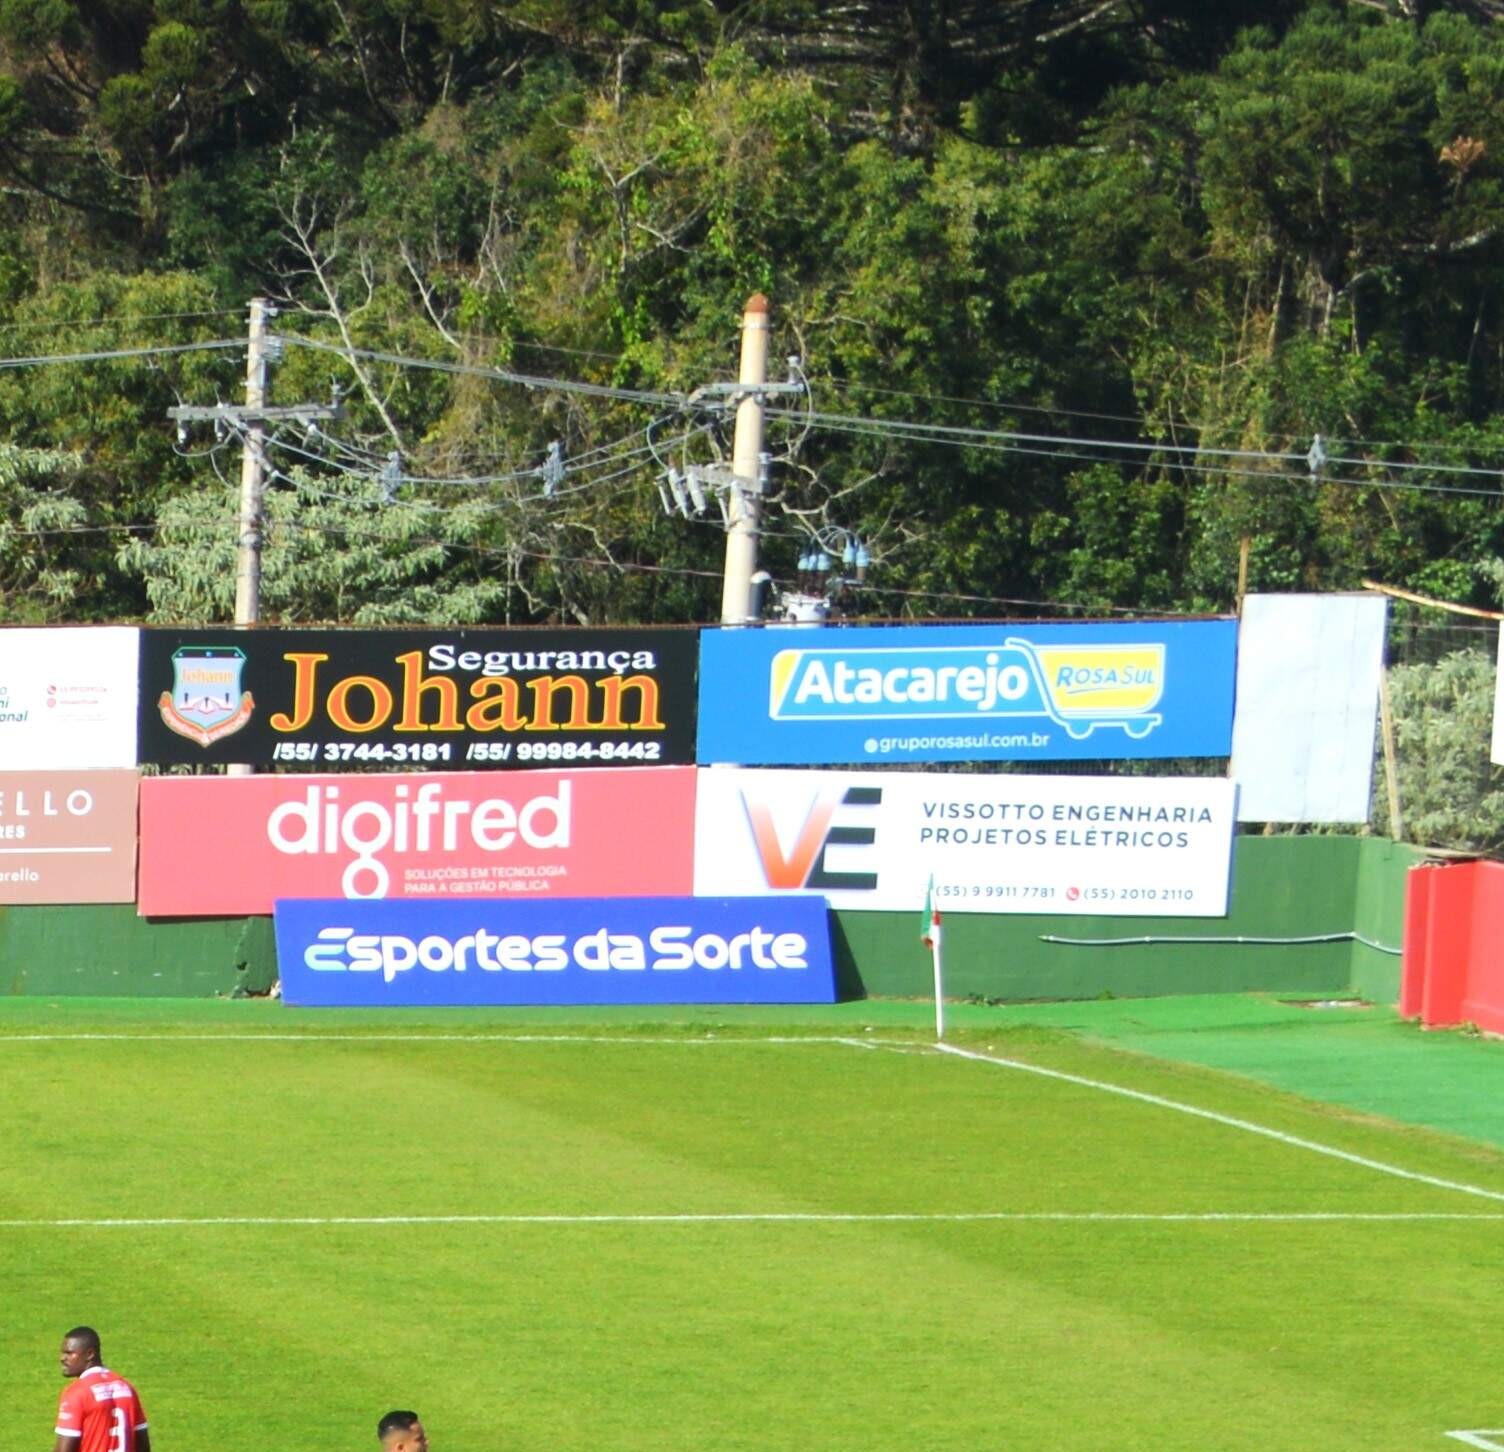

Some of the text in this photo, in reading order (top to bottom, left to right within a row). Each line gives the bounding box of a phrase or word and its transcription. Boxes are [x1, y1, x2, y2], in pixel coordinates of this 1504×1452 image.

[428, 644, 656, 677] Segurança
[268, 650, 666, 733] Johann
[793, 652, 1029, 711] Atacarejo
[272, 741, 661, 762] /55/ 3744-3181 /55/ 99984-8442
[879, 733, 1051, 756] gruporosasul.com.br
[922, 801, 1214, 825] VISSOTTO ENGENHARIA
[267, 779, 572, 899] digifred
[918, 824, 1190, 848] PROJETOS ELÉTRICOS
[404, 865, 568, 881] SOLUÇÕES EM TECNOLOGIA
[404, 882, 436, 894] PARA
[439, 883, 448, 893] A
[449, 880, 497, 893] GESTÃO
[935, 885, 968, 897] (55)
[972, 886, 981, 897] 9
[1083, 887, 1194, 901] (55) 2010 2110
[304, 925, 809, 984] Esportes da Sorte
